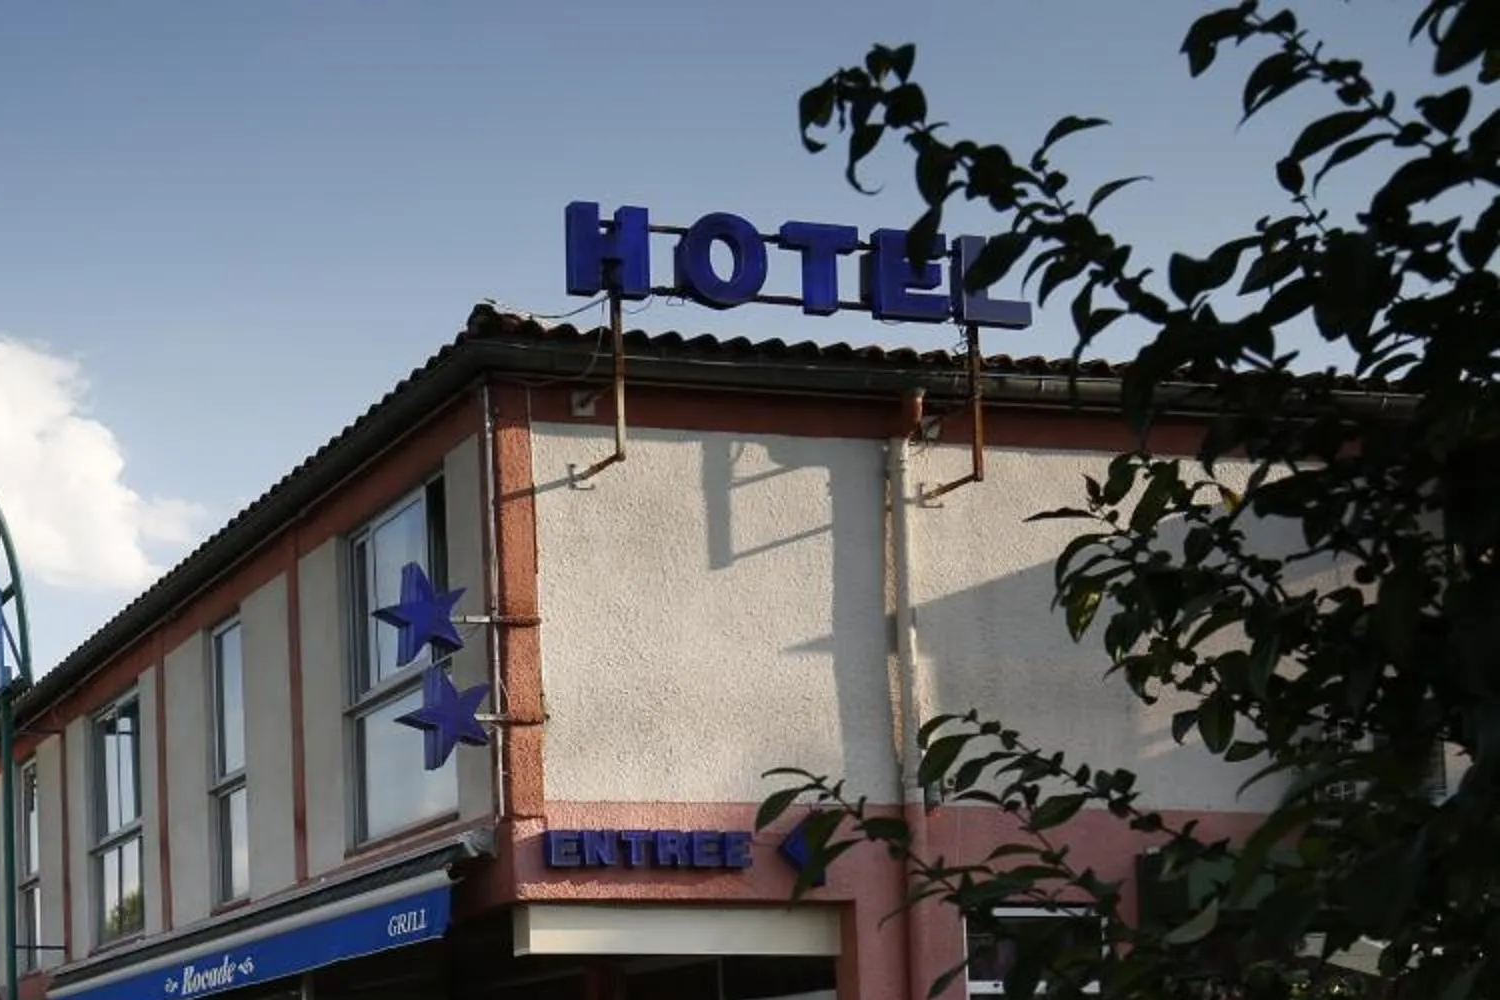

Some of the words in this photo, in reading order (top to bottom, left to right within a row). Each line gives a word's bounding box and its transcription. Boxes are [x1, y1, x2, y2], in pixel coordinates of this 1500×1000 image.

[565, 201, 1033, 329] HOTEL
[546, 830, 752, 868] ENTREE
[387, 908, 428, 937] GRILL
[181, 954, 237, 995] Rocade
